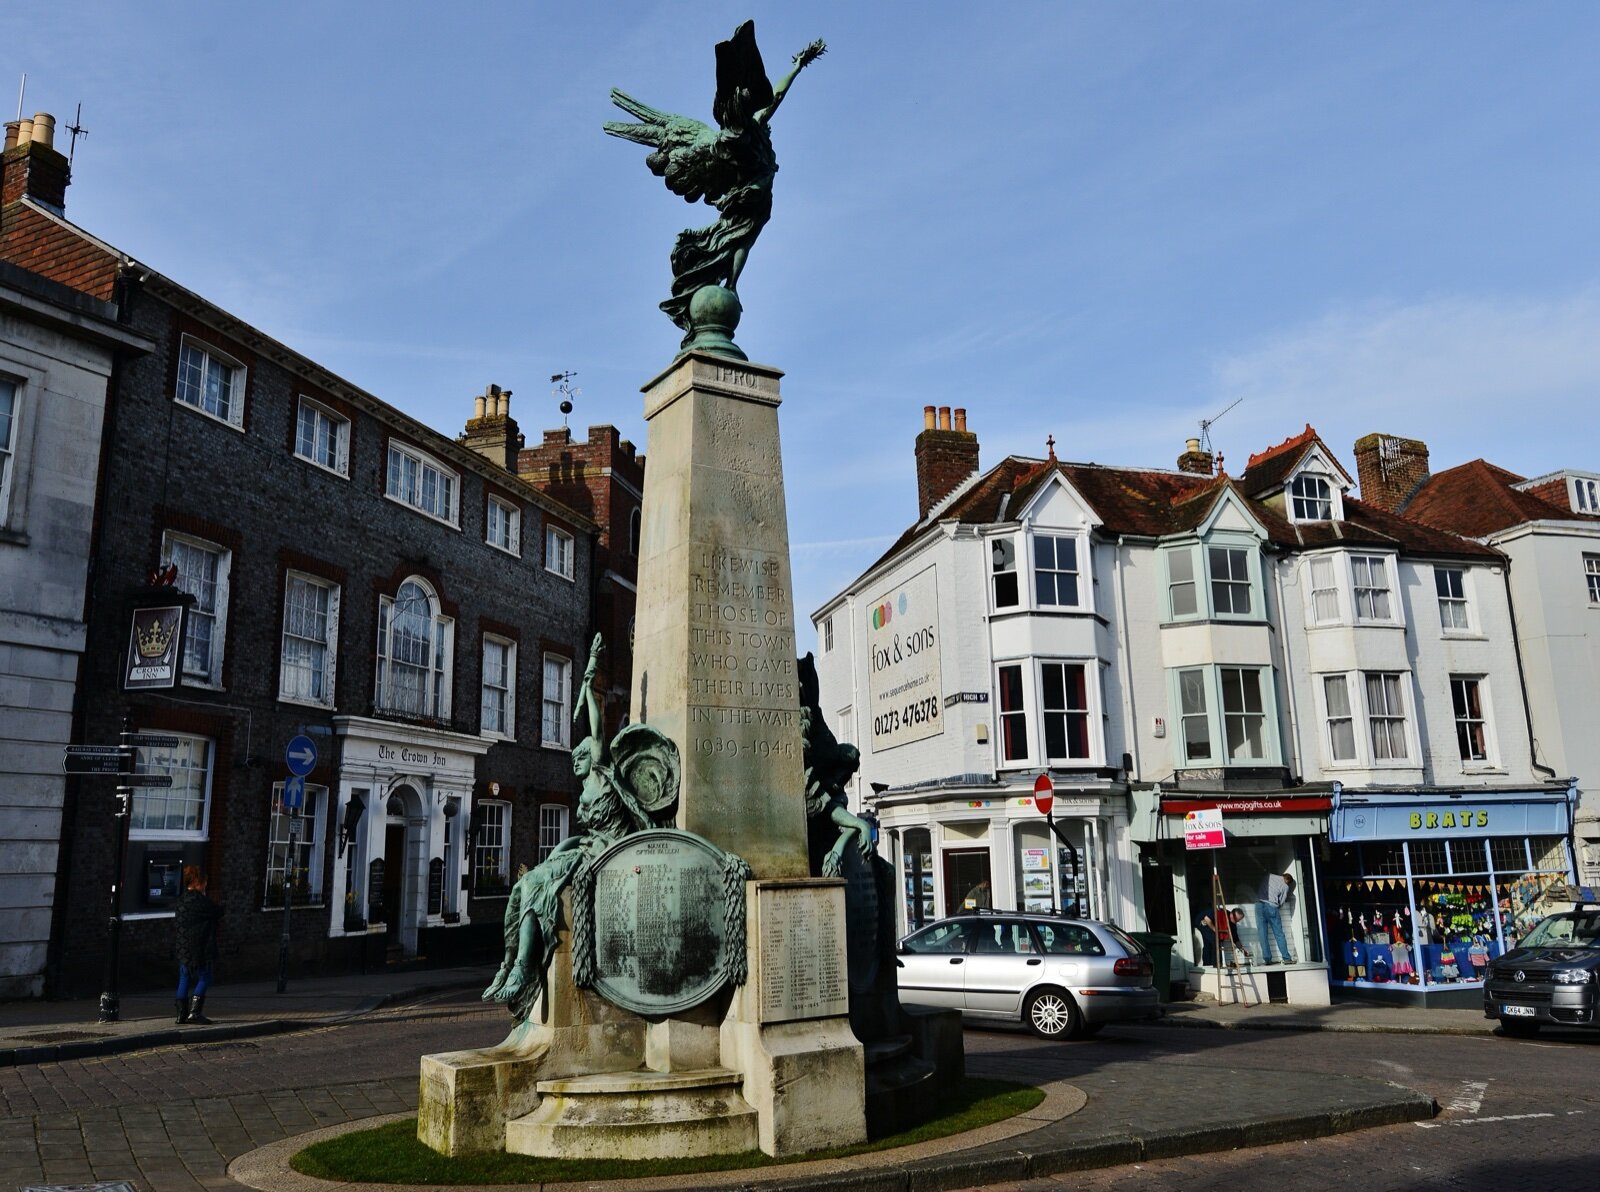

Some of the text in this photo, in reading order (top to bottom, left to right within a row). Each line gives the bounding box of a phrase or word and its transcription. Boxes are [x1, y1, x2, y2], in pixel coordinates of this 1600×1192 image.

[702, 553, 780, 577] LIKEWISE
[695, 576, 786, 603] REMEMBER
[695, 603, 787, 626] THOSE OF
[692, 628, 791, 650] THIS TOWN
[872, 625, 935, 674] fox & sons
[136, 666, 166, 674] CROWN
[692, 653, 792, 675] WHO GAVE
[692, 678, 793, 699] THEIR LIVES
[963, 693, 978, 701] HIGH
[692, 707, 793, 727] IN THE WAR
[874, 695, 938, 737] 01273 476378
[378, 744, 446, 767] The Crown Inn
[695, 736, 794, 760] 1939-1945
[1216, 800, 1282, 811] www.mojogifts.co.uk
[1185, 820, 1222, 831] fox & sons
[1409, 810, 1489, 830] BRATS
[1186, 832, 1207, 841] for sale
